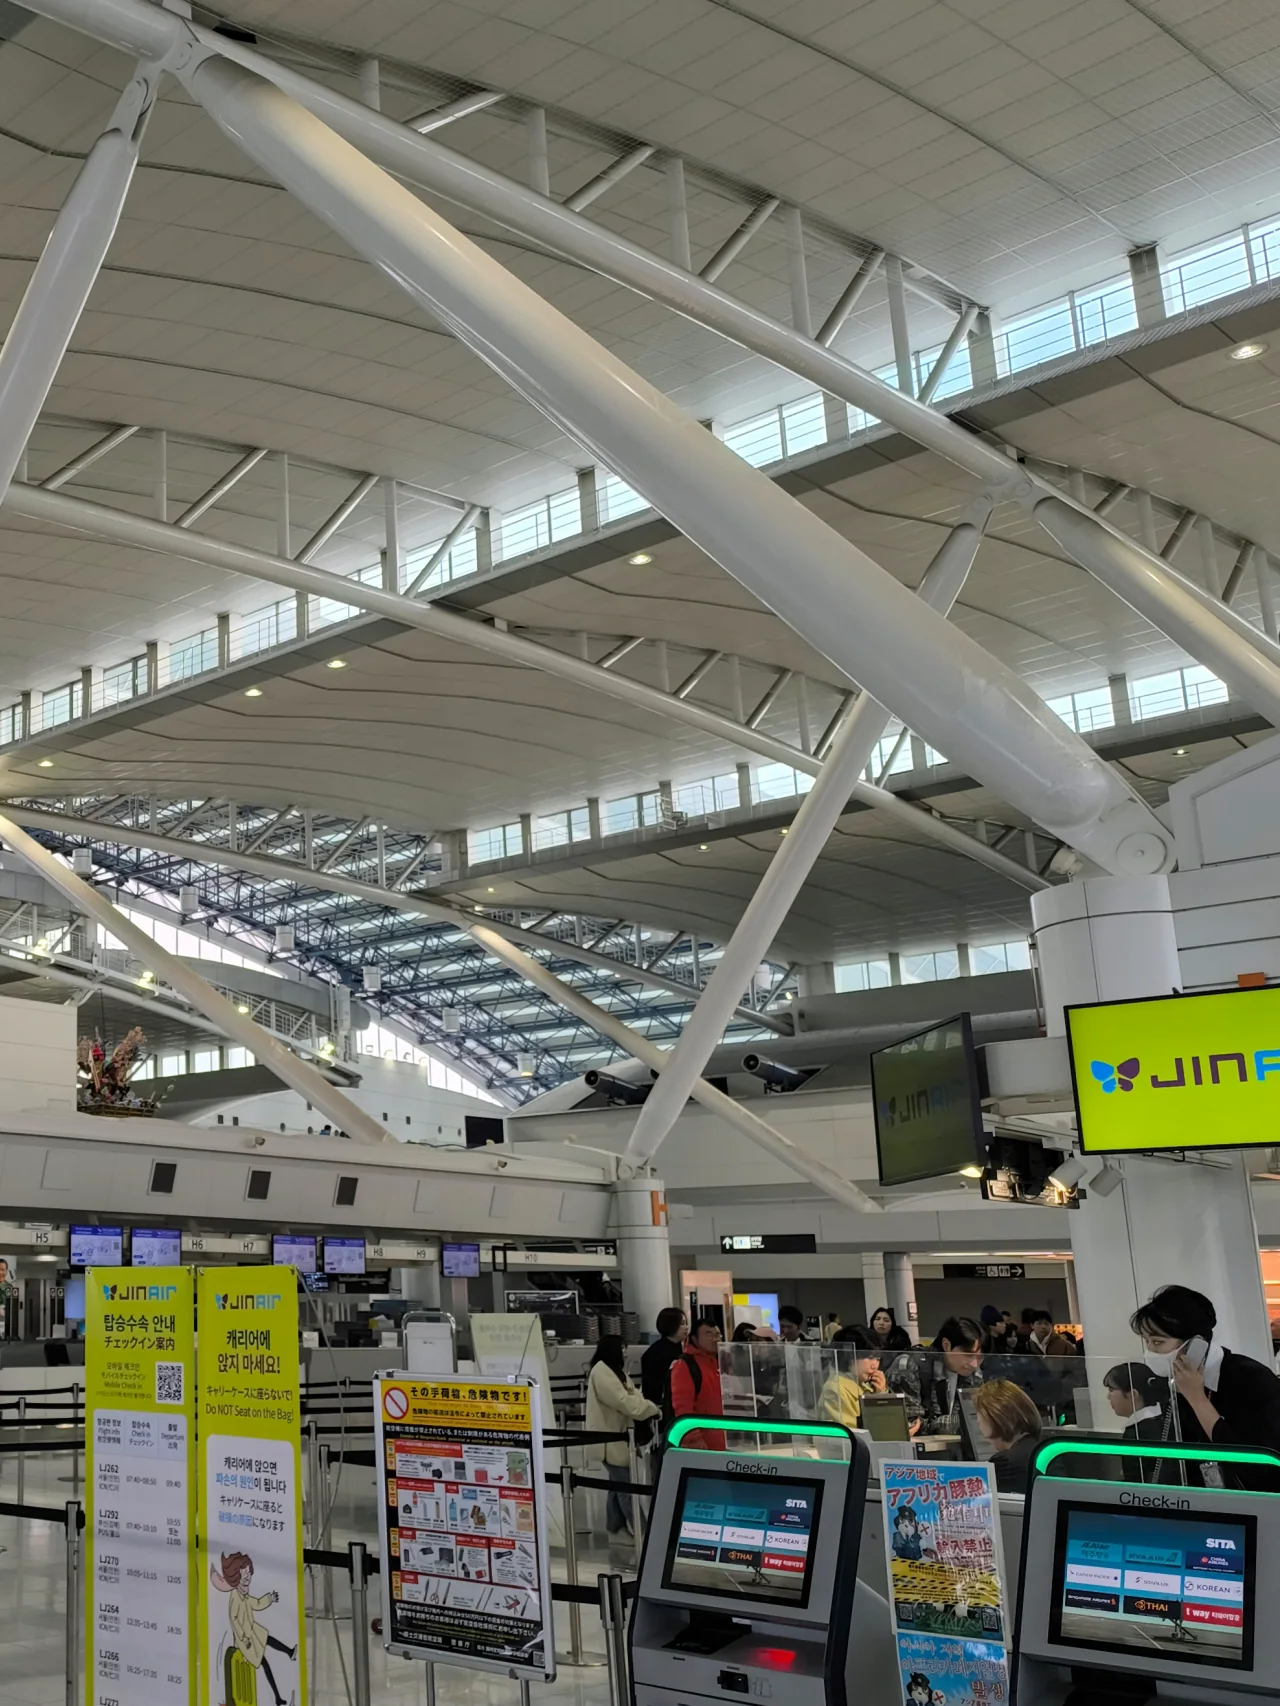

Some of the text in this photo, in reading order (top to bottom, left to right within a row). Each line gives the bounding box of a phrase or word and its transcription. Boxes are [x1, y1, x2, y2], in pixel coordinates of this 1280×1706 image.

[1150, 1048, 1280, 1088] JINA
[651, 1190, 668, 1226] H
[36, 1233, 49, 1243] H5
[191, 1240, 203, 1250] H6
[243, 1242, 254, 1252] H7
[417, 1249, 426, 1258] H9
[525, 1253, 537, 1262] H10
[58, 1288, 63, 1296] G
[119, 1285, 177, 1300] JINAIR
[230, 1294, 281, 1310] JINAIR
[104, 1315, 176, 1333] 탑승수속 안내
[104, 1337, 175, 1351] チェックイン案内
[227, 1329, 271, 1350] 캐리어에
[218, 1353, 281, 1375] 앉지 마세요!
[102, 1372, 146, 1380] モバイルチェックイン
[206, 1386, 293, 1401] キャリーケースに座らないで!
[411, 1387, 527, 1402] その手荷物、危険物です!
[206, 1404, 293, 1424] Do NOT Seat on the Bag!
[132, 1421, 150, 1429] 탑승수속
[168, 1424, 178, 1432] 출발
[129, 1439, 154, 1447] チェックイン
[99, 1464, 119, 1473] LJ262
[224, 1457, 277, 1475] 캐리어에 앉으면
[726, 1460, 778, 1476] Check-in
[885, 1467, 945, 1482] アジア地域で
[216, 1473, 287, 1494] 파손의 원인이 됩니다
[887, 1477, 986, 1507] アフリカ豚熱
[786, 1499, 807, 1508] SITA
[1119, 1491, 1190, 1510] Check-in
[99, 1509, 119, 1519] LJ292
[1206, 1538, 1236, 1550] SITA
[99, 1555, 119, 1566] LJ270
[736, 1553, 752, 1561] THAI
[167, 1576, 181, 1584] 12:05
[1197, 1584, 1231, 1593] KOREAN
[100, 1603, 119, 1614] LJ264
[1146, 1602, 1168, 1611] THAI
[100, 1649, 119, 1661] LJ266
[971, 1680, 1004, 1701] 발생
